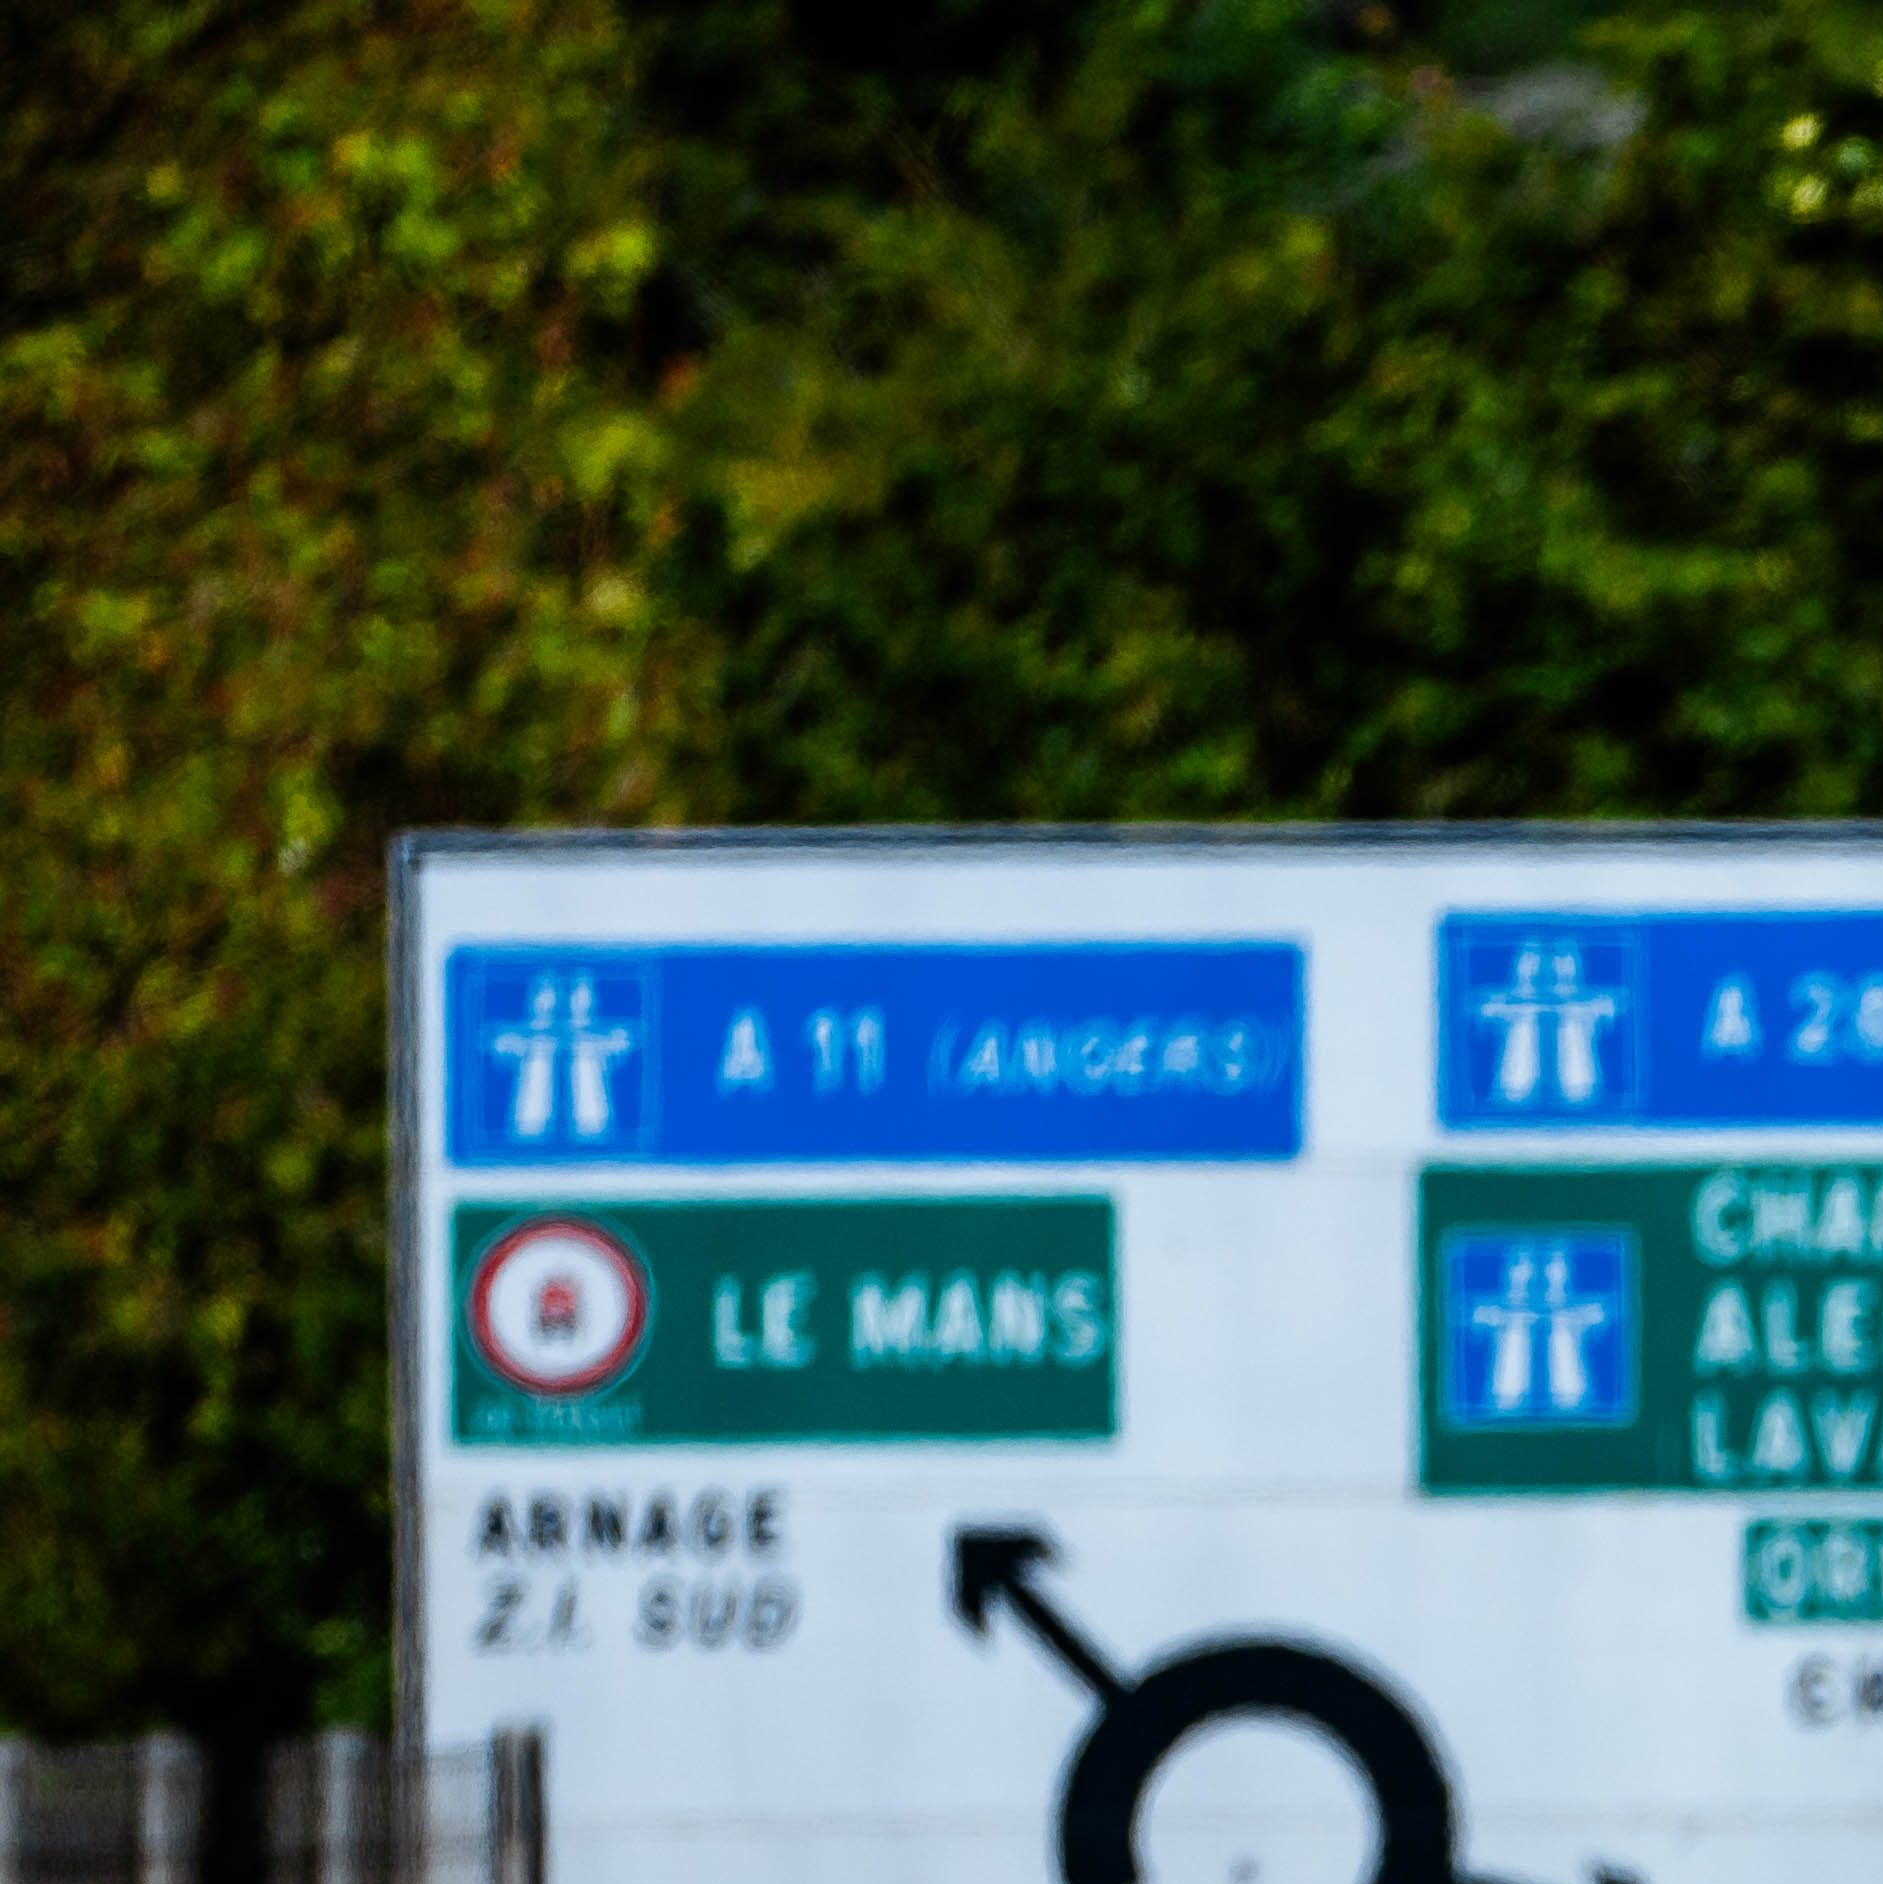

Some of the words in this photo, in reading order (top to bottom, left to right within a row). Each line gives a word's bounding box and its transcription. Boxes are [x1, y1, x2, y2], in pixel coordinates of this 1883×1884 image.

[716, 1003, 774, 1094] A
[804, 1005, 885, 1094] 11
[1703, 969, 1762, 1060] A
[714, 1272, 816, 1368] LE
[851, 1270, 1102, 1366] MANS
[471, 1485, 788, 1558] ARNAGE
[632, 1572, 800, 1651] SUD
